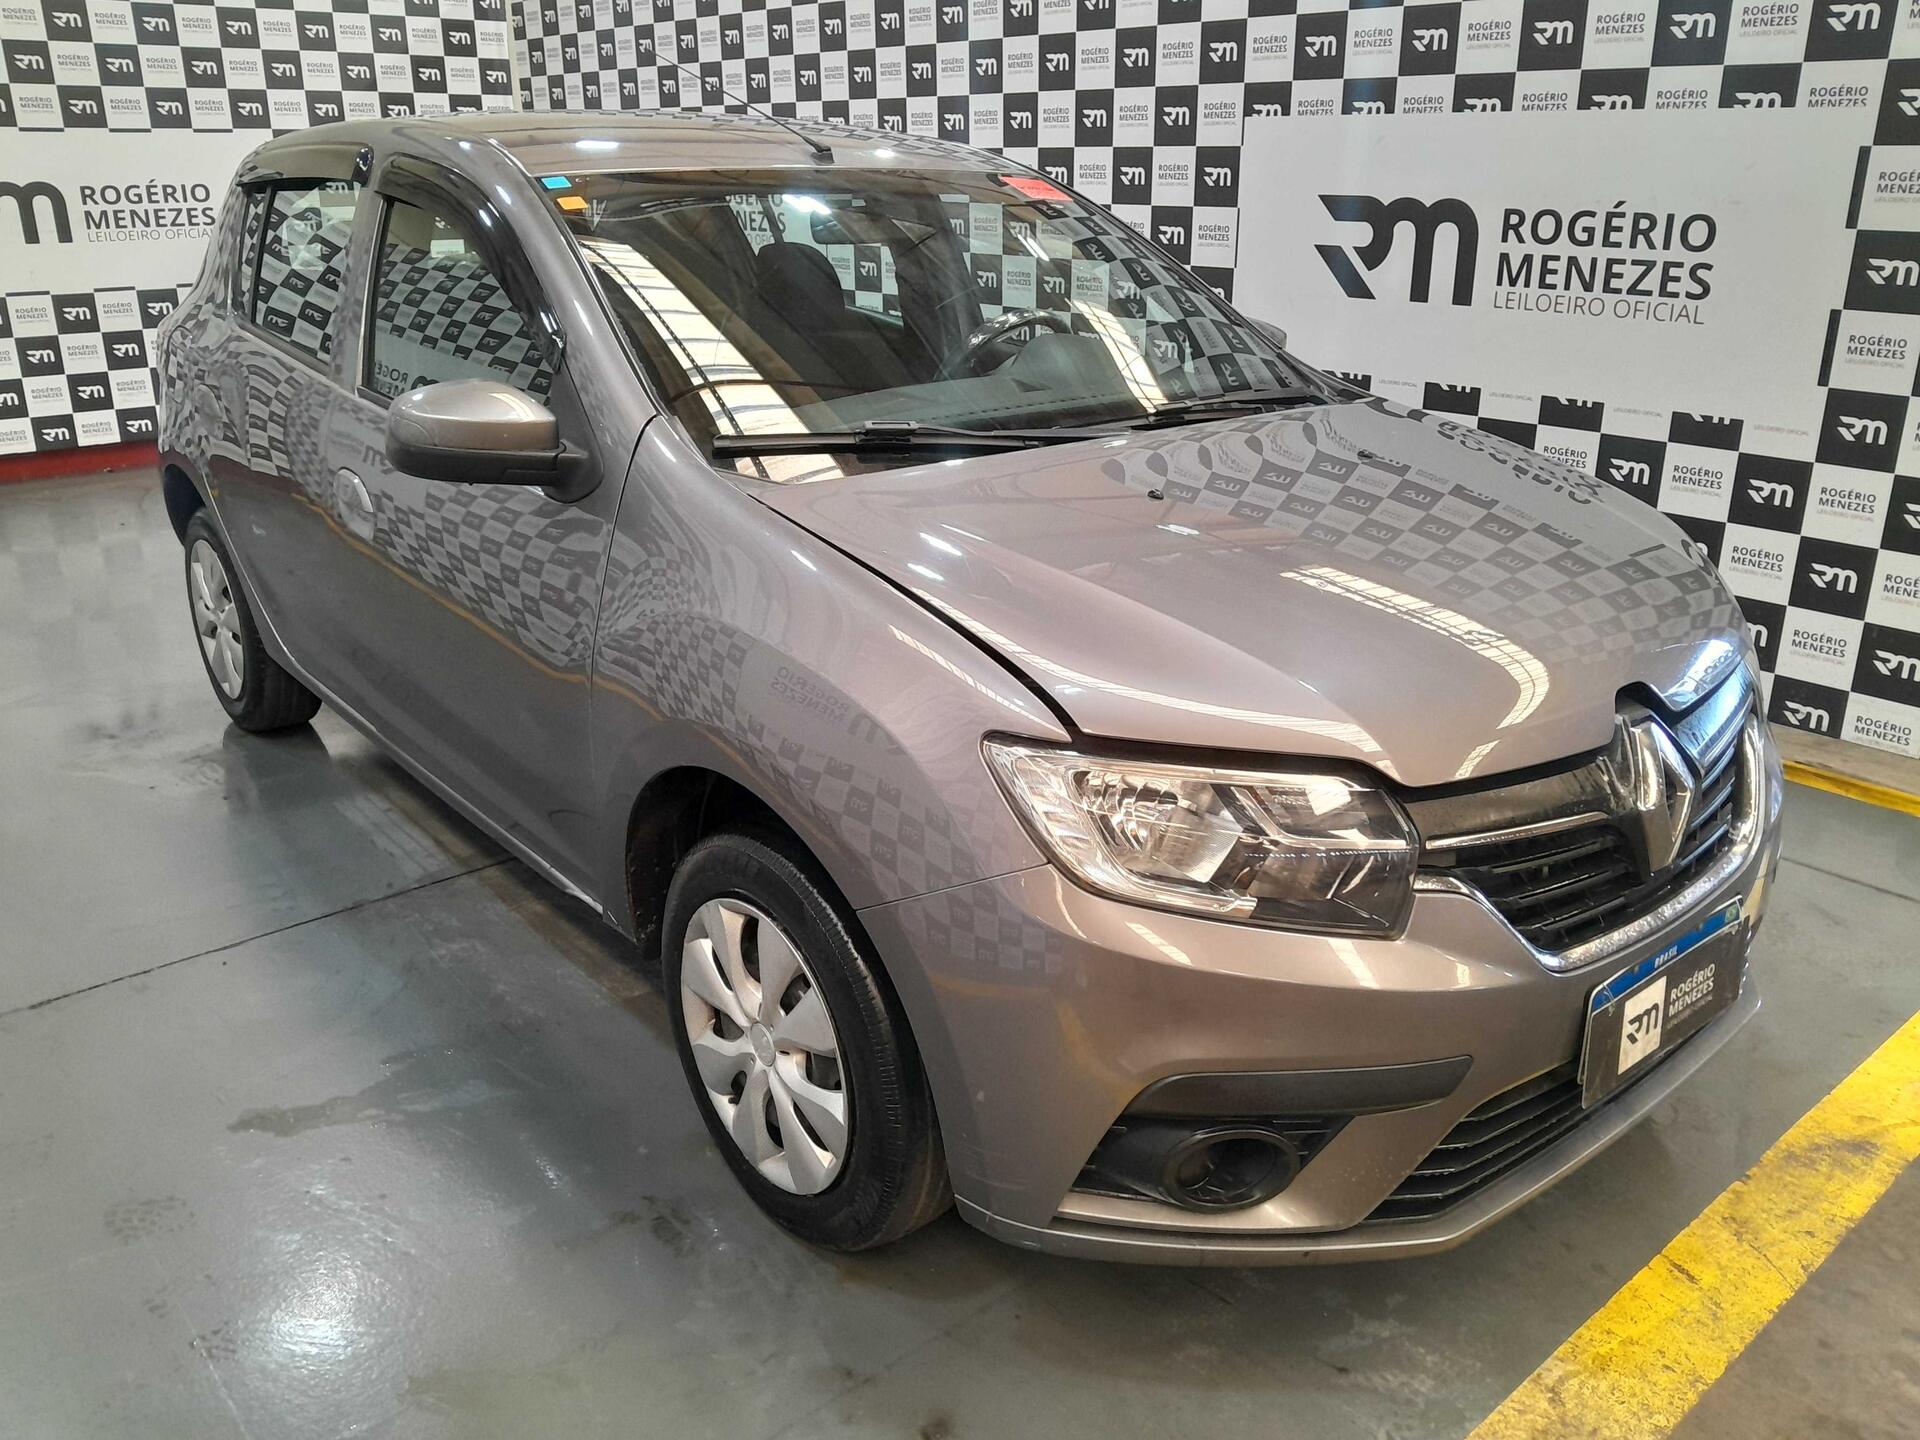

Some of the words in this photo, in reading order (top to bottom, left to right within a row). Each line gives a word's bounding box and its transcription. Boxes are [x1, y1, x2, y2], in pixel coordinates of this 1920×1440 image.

[1743, 1, 1799, 17] ROGÉRIO
[1597, 11, 1646, 25] ROGÉRIO
[1741, 15, 1798, 29] MENEZES
[1467, 31, 1511, 42] MENEZES
[1595, 24, 1645, 36] MENEZES
[1253, 44, 1288, 55] MENEZES
[1353, 38, 1393, 49] MENEZES
[1657, 88, 1708, 100] ROGÉRIO
[1810, 84, 1869, 98] ROGÉRIO
[1879, 169, 1920, 182] ROGÉ
[80, 179, 210, 206] ROGÉRIO
[1876, 184, 1920, 194] MENEZ
[84, 206, 216, 230] MENEZES
[88, 229, 160, 242] LEILOEIRO
[165, 228, 214, 240] OFICIA
[1501, 201, 1717, 253] ROGÉRIO
[1496, 252, 1714, 301] MENEZES
[1493, 291, 1606, 317] LEILOEIRO
[1614, 299, 1705, 325] OFICIAL
[1849, 334, 1908, 349] ROGÉRIO
[1847, 345, 1906, 360] MENEZES
[1544, 446, 1587, 459] ROGÉRIO
[1673, 464, 1723, 480] ROGÉRIO
[1672, 474, 1722, 490] MENEZES
[1820, 486, 1877, 504] ROGÉRIO
[1818, 497, 1875, 515] MENEZES
[1732, 545, 1784, 563] ROGÉRIO
[1731, 555, 1783, 573] MENEZES
[1885, 574, 1920, 588] ROGÉ
[1883, 584, 1920, 599] MENE
[1793, 629, 1847, 649] ROGÉRIO
[1791, 638, 1845, 659] MENEZES
[1856, 715, 1912, 737] ROGÉRIO
[1854, 724, 1910, 747] MENEZES
[1655, 945, 1678, 969] BRASIL
[1671, 964, 1715, 1003] ROGÉRIO
[1669, 977, 1714, 1017] MENEZES
